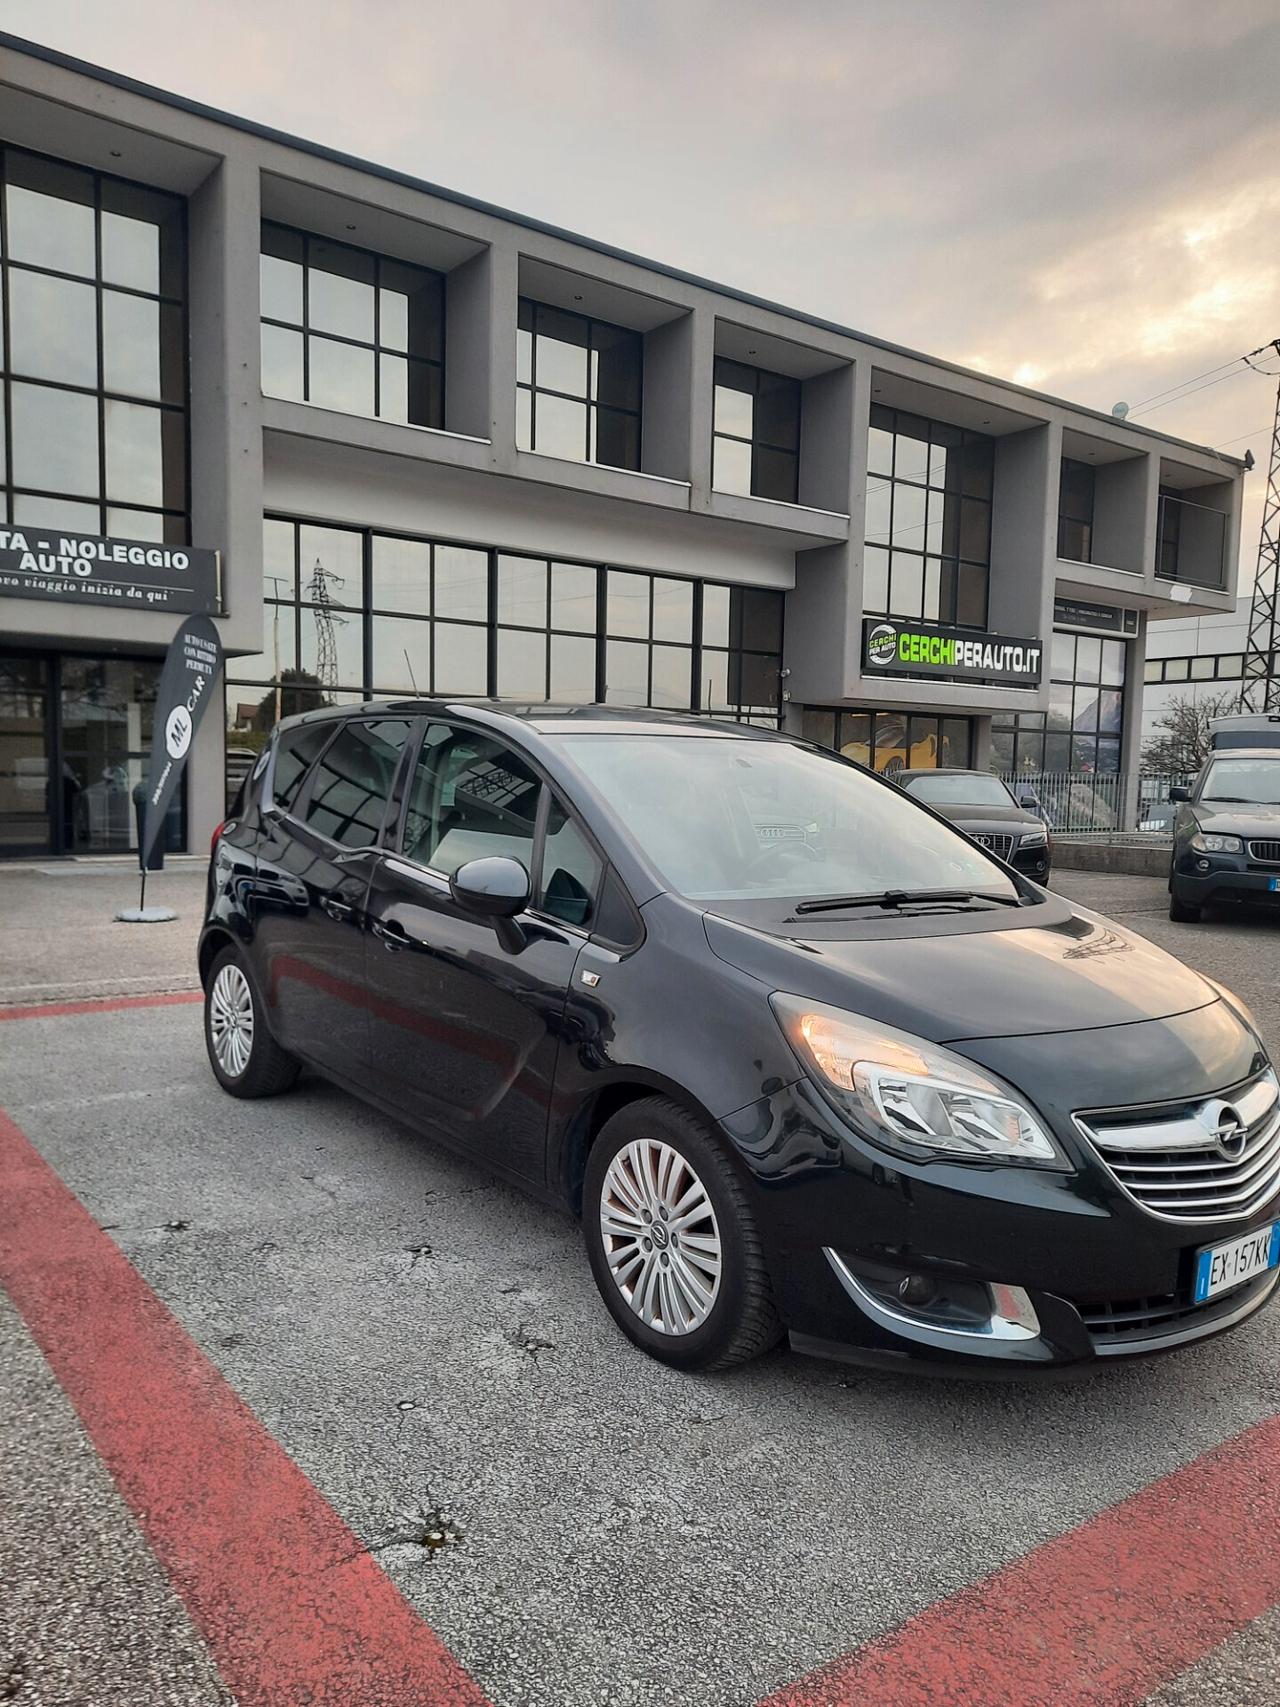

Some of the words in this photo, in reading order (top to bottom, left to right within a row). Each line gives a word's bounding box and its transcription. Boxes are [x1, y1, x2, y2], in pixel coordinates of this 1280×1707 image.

[19, 552, 93, 577] AUTO
[59, 538, 190, 570] NOLEGGIO
[0, 576, 19, 586] vo
[24, 576, 77, 593] viaggio
[81, 582, 123, 597] inizia
[126, 586, 143, 599] da
[146, 590, 169, 603] qui
[869, 633, 897, 648] CERCHI
[869, 646, 881, 656] PER
[880, 641, 897, 652] AUTO
[899, 632, 1041, 674] CERCHIPERAUTO.IT
[185, 658, 213, 675] PERMUTA
[170, 717, 188, 748] ML
[187, 675, 206, 713] CAR
